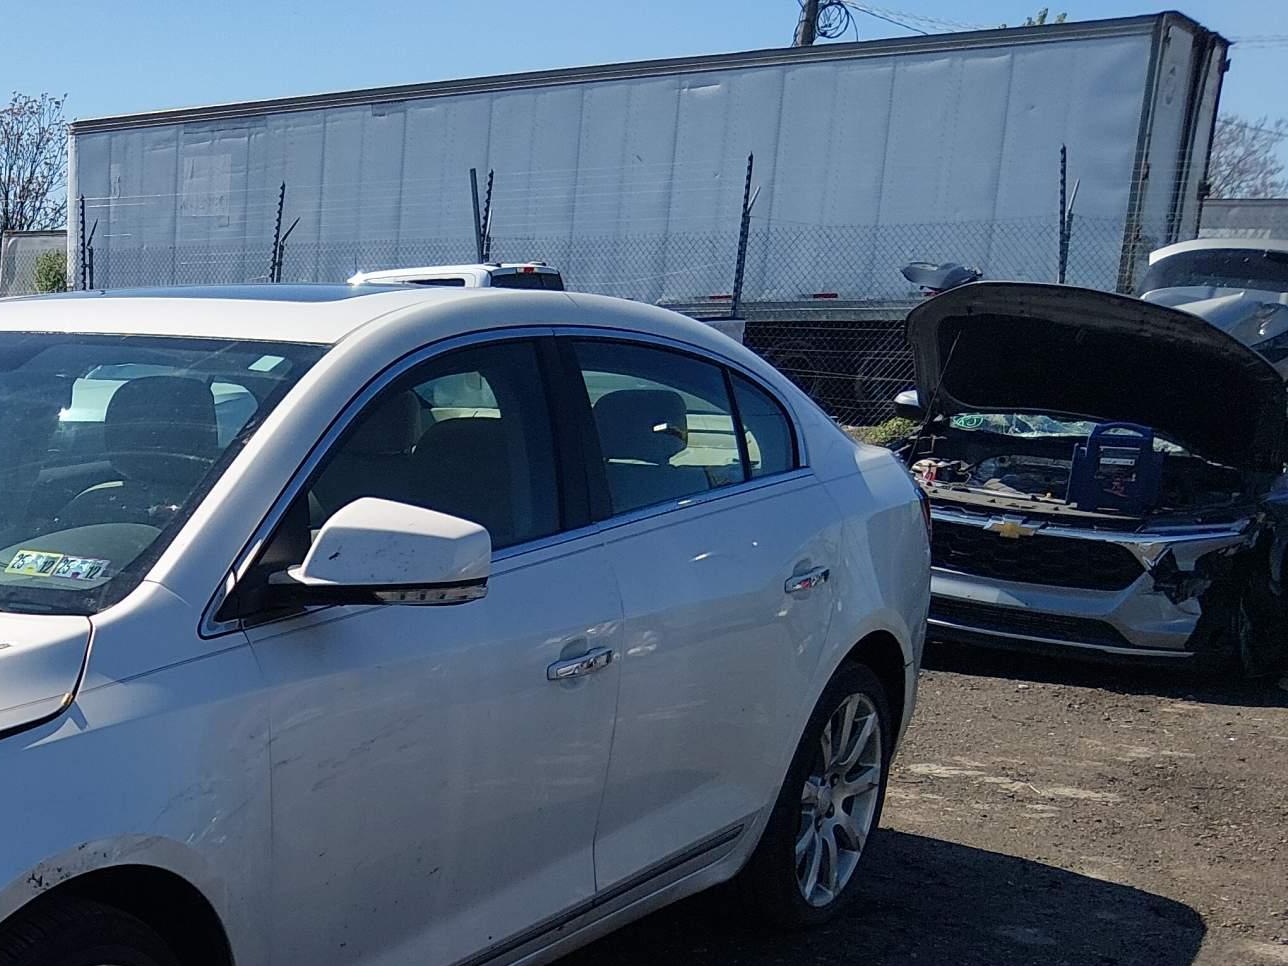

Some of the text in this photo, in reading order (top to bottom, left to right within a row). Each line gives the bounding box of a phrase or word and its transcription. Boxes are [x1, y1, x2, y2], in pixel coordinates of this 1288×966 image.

[11, 553, 55, 574] 25 12
[57, 556, 102, 580] 25 12
